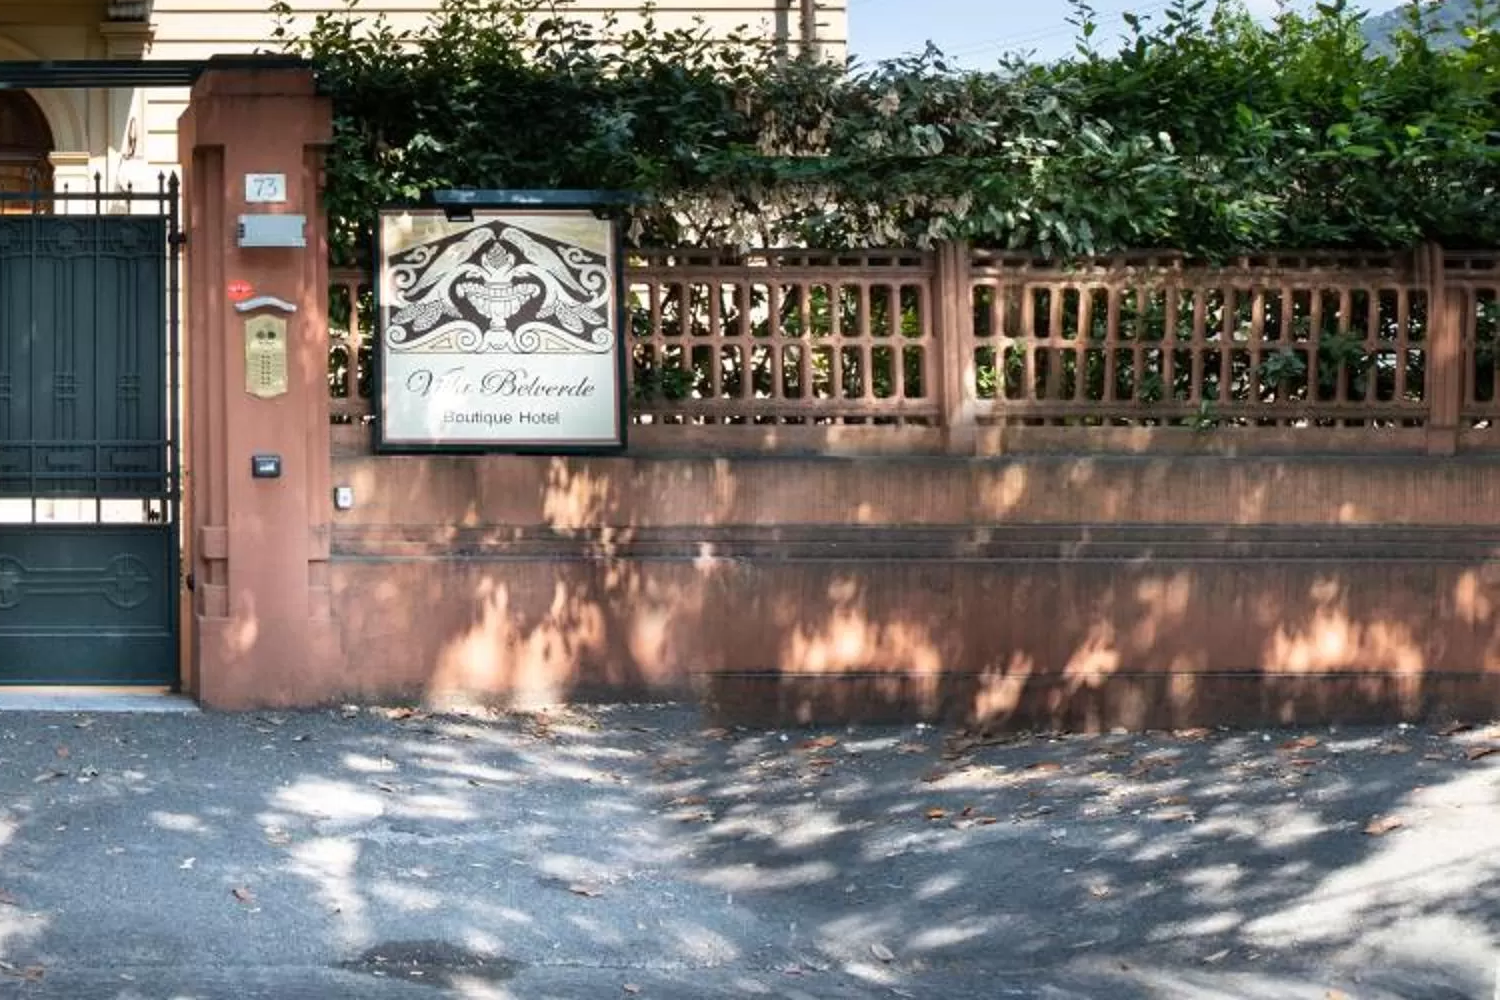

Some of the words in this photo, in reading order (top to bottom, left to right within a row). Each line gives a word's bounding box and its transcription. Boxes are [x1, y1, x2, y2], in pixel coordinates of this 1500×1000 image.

[253, 176, 278, 198] 73
[405, 366, 476, 398] Vla
[479, 367, 595, 398] Belverde
[443, 411, 513, 428] Boutique
[518, 410, 561, 425] Hotel
